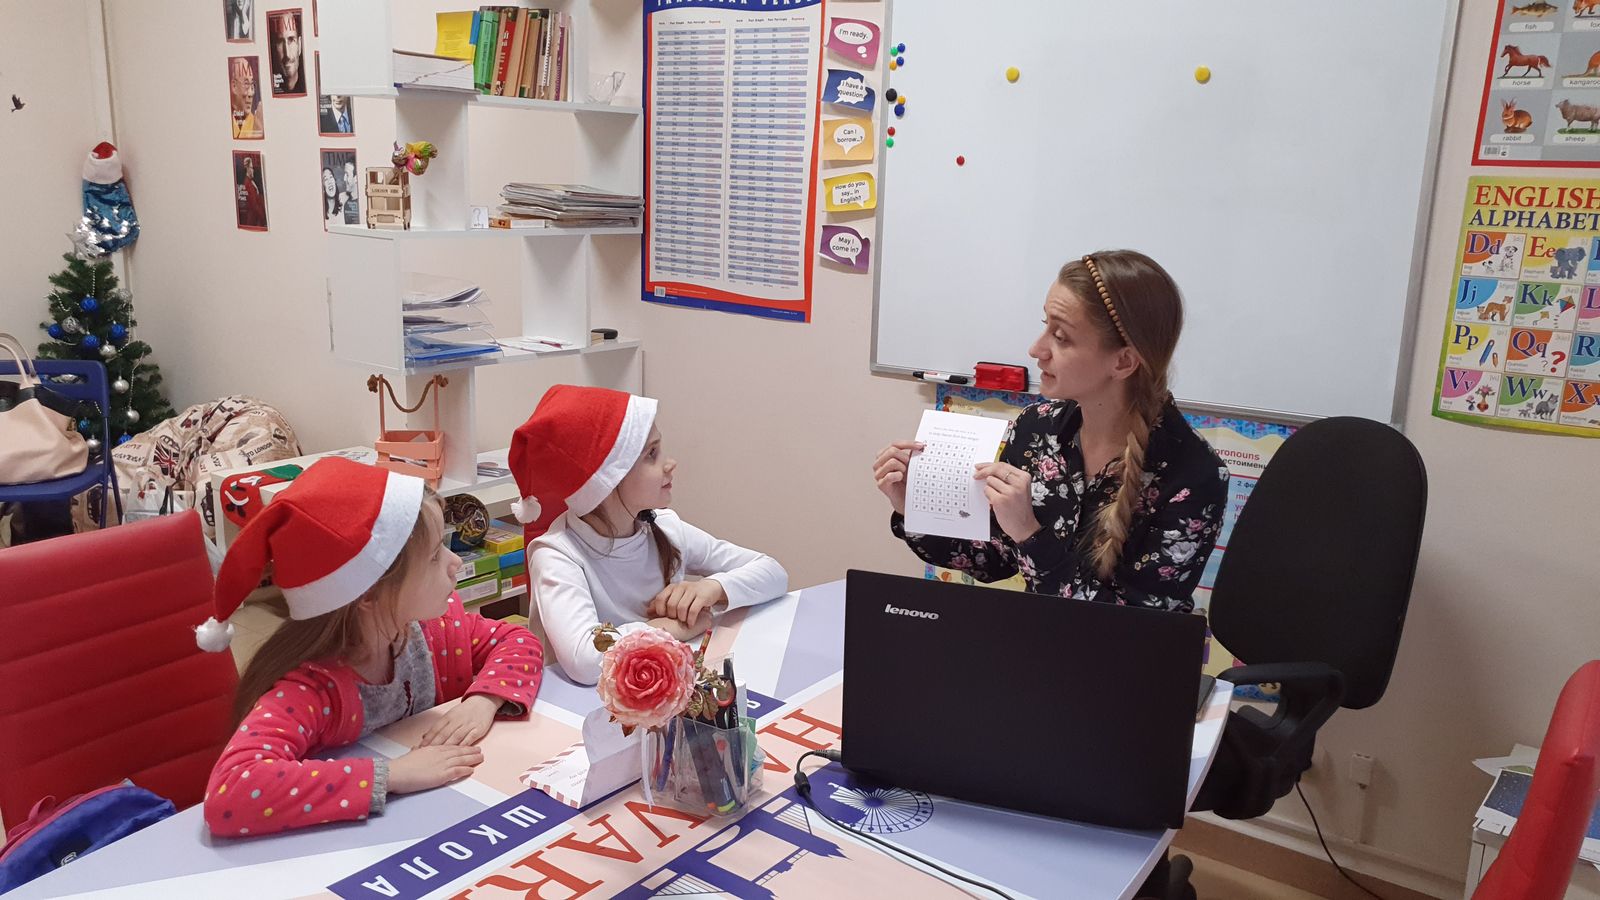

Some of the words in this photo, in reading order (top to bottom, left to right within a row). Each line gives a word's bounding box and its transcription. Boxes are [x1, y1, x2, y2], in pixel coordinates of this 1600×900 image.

[849, 30, 869, 40] ready.
[845, 82, 859, 90] have
[854, 181, 866, 189] you
[1473, 185, 1600, 209] ENGLISH
[1468, 209, 1600, 230] ALPHABET
[832, 244, 850, 252] come
[838, 236, 852, 245] May
[1468, 233, 1501, 255] Dd
[1527, 236, 1557, 258] Ee
[1459, 279, 1477, 305] Jj
[1519, 283, 1553, 306] Kk
[1452, 324, 1479, 351] Pp
[1512, 330, 1548, 358] Qq
[1448, 369, 1473, 391] Vv
[1505, 375, 1548, 399] Ww
[254, 442, 273, 455] LONDON
[884, 603, 940, 620] lenovo
[361, 804, 547, 898] ШКОЛА
